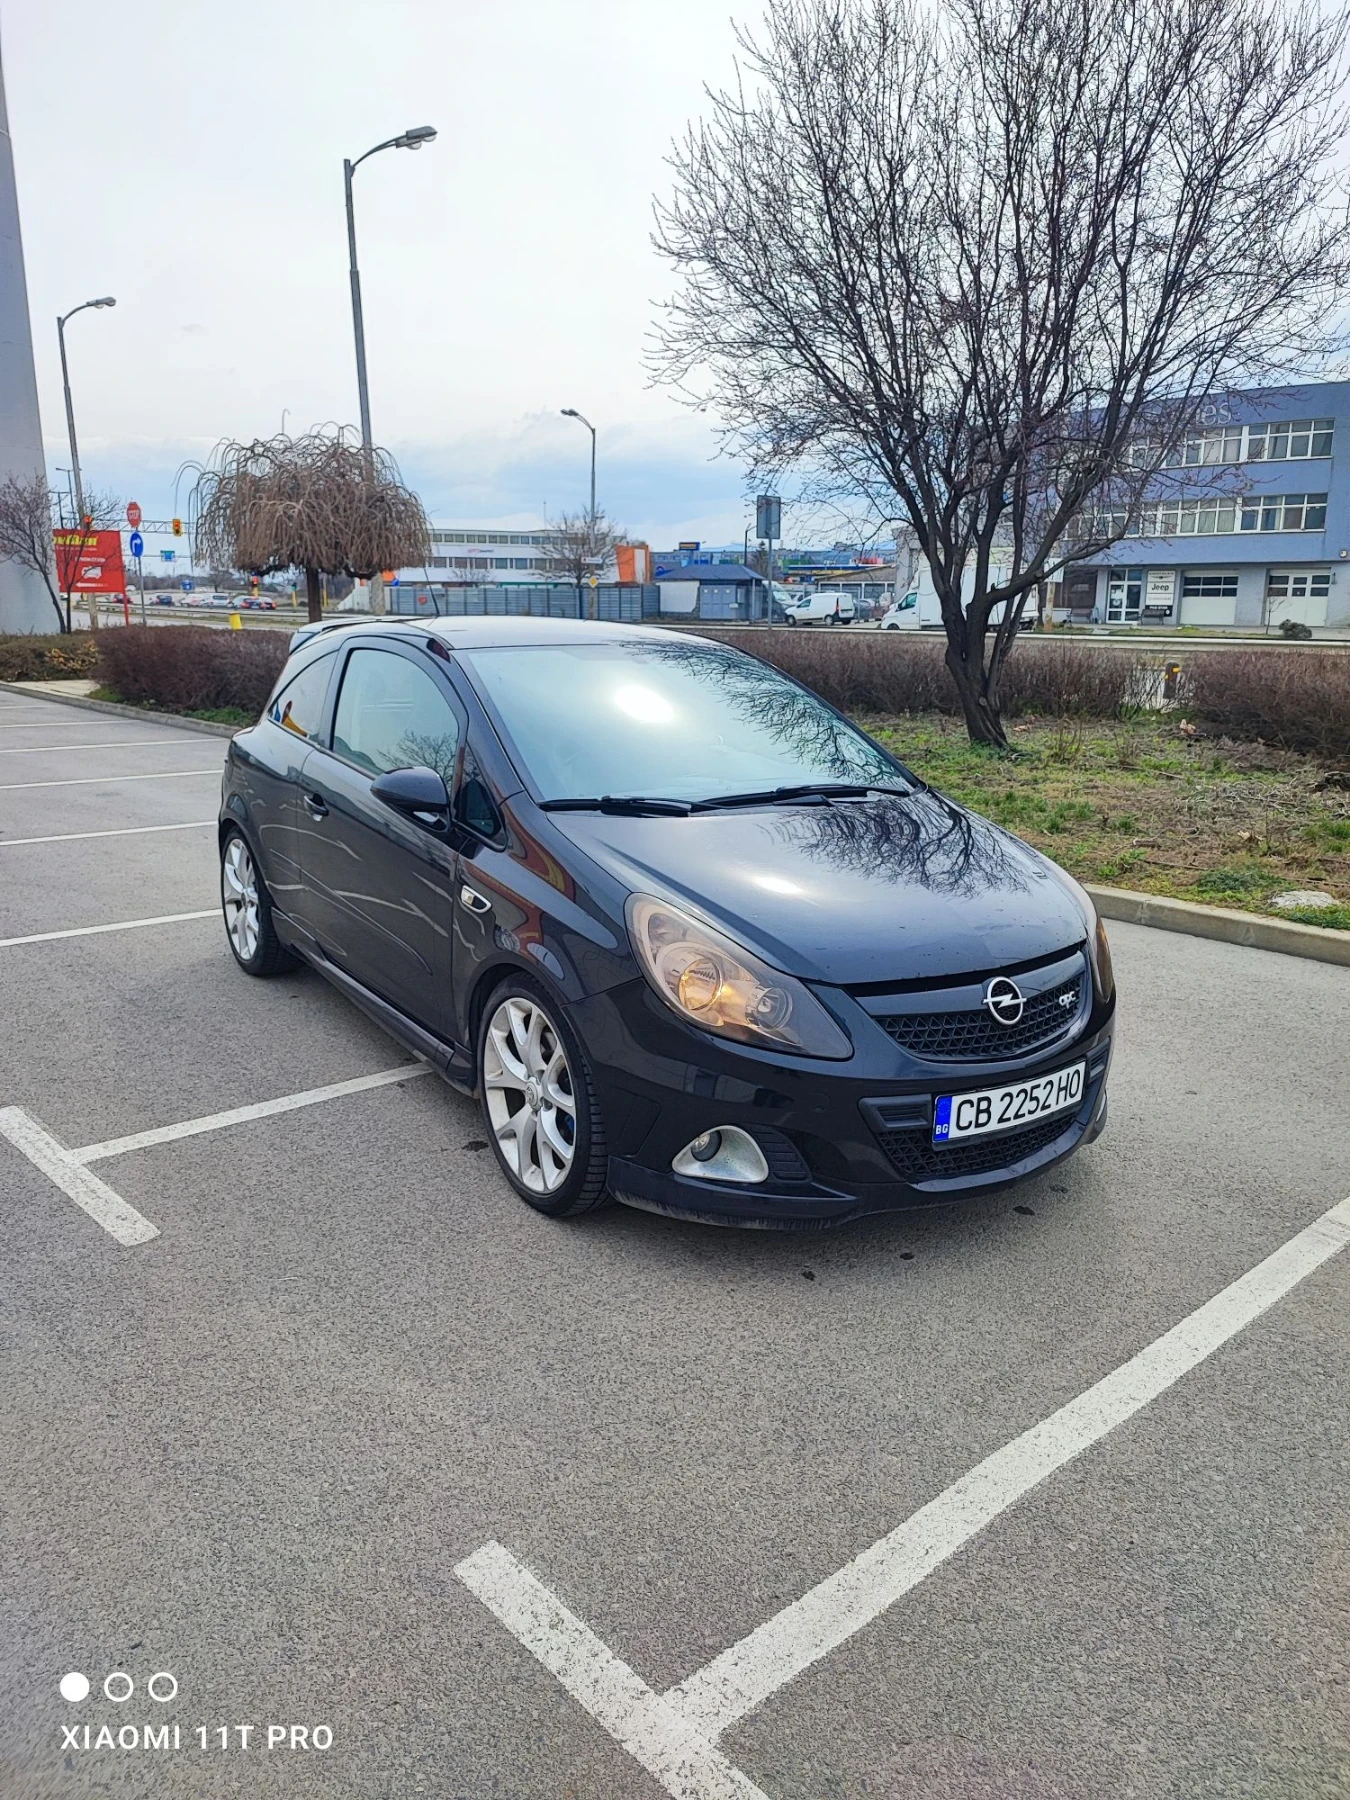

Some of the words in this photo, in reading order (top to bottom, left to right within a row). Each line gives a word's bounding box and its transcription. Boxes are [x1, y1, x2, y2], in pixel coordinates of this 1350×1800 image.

[128, 509, 141, 519] STOP
[1151, 583, 1170, 592] Jeep
[955, 1095, 992, 1131] CB
[997, 1079, 1054, 1124] 2252
[1055, 1068, 1081, 1106] HO
[935, 1123, 949, 1135] BG
